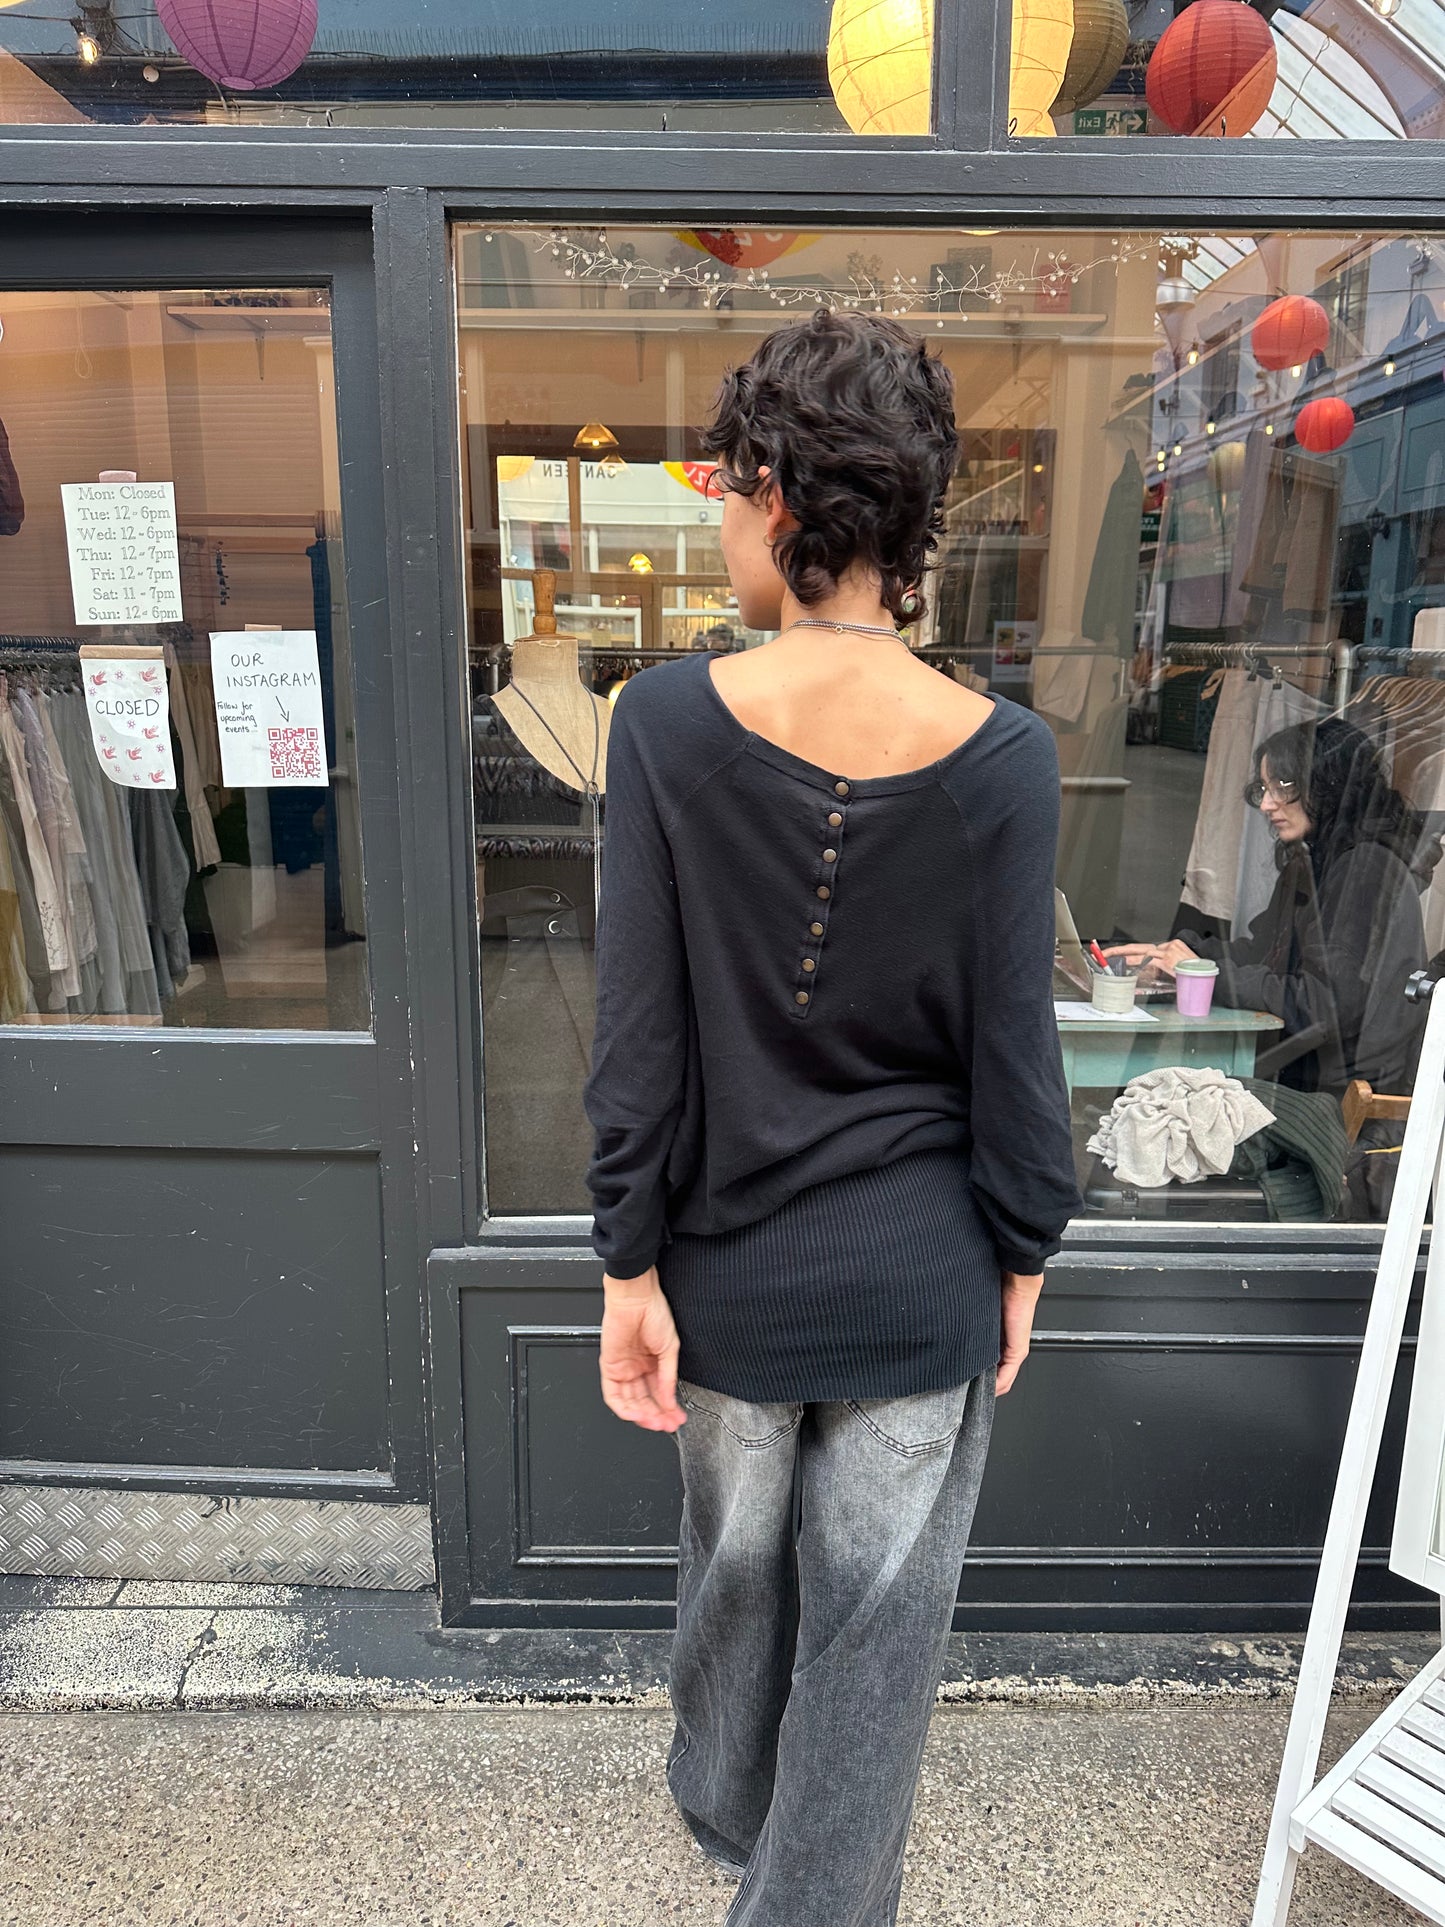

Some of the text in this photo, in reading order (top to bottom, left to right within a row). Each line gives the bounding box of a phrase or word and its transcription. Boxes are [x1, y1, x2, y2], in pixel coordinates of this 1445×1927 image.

[78, 485, 166, 500] Mon: Closed
[78, 507, 110, 520] Tue:
[77, 527, 117, 540] Wed:
[76, 548, 112, 560] Thu:
[90, 567, 116, 581] Fri:
[92, 587, 119, 600] Sat:
[88, 607, 121, 620] Sun:
[231, 652, 264, 667] OUR
[226, 671, 317, 688] INSTAGRAM
[95, 698, 160, 717] CLOSED
[217, 700, 254, 715] Follow for
[220, 714, 258, 728] upcoming
